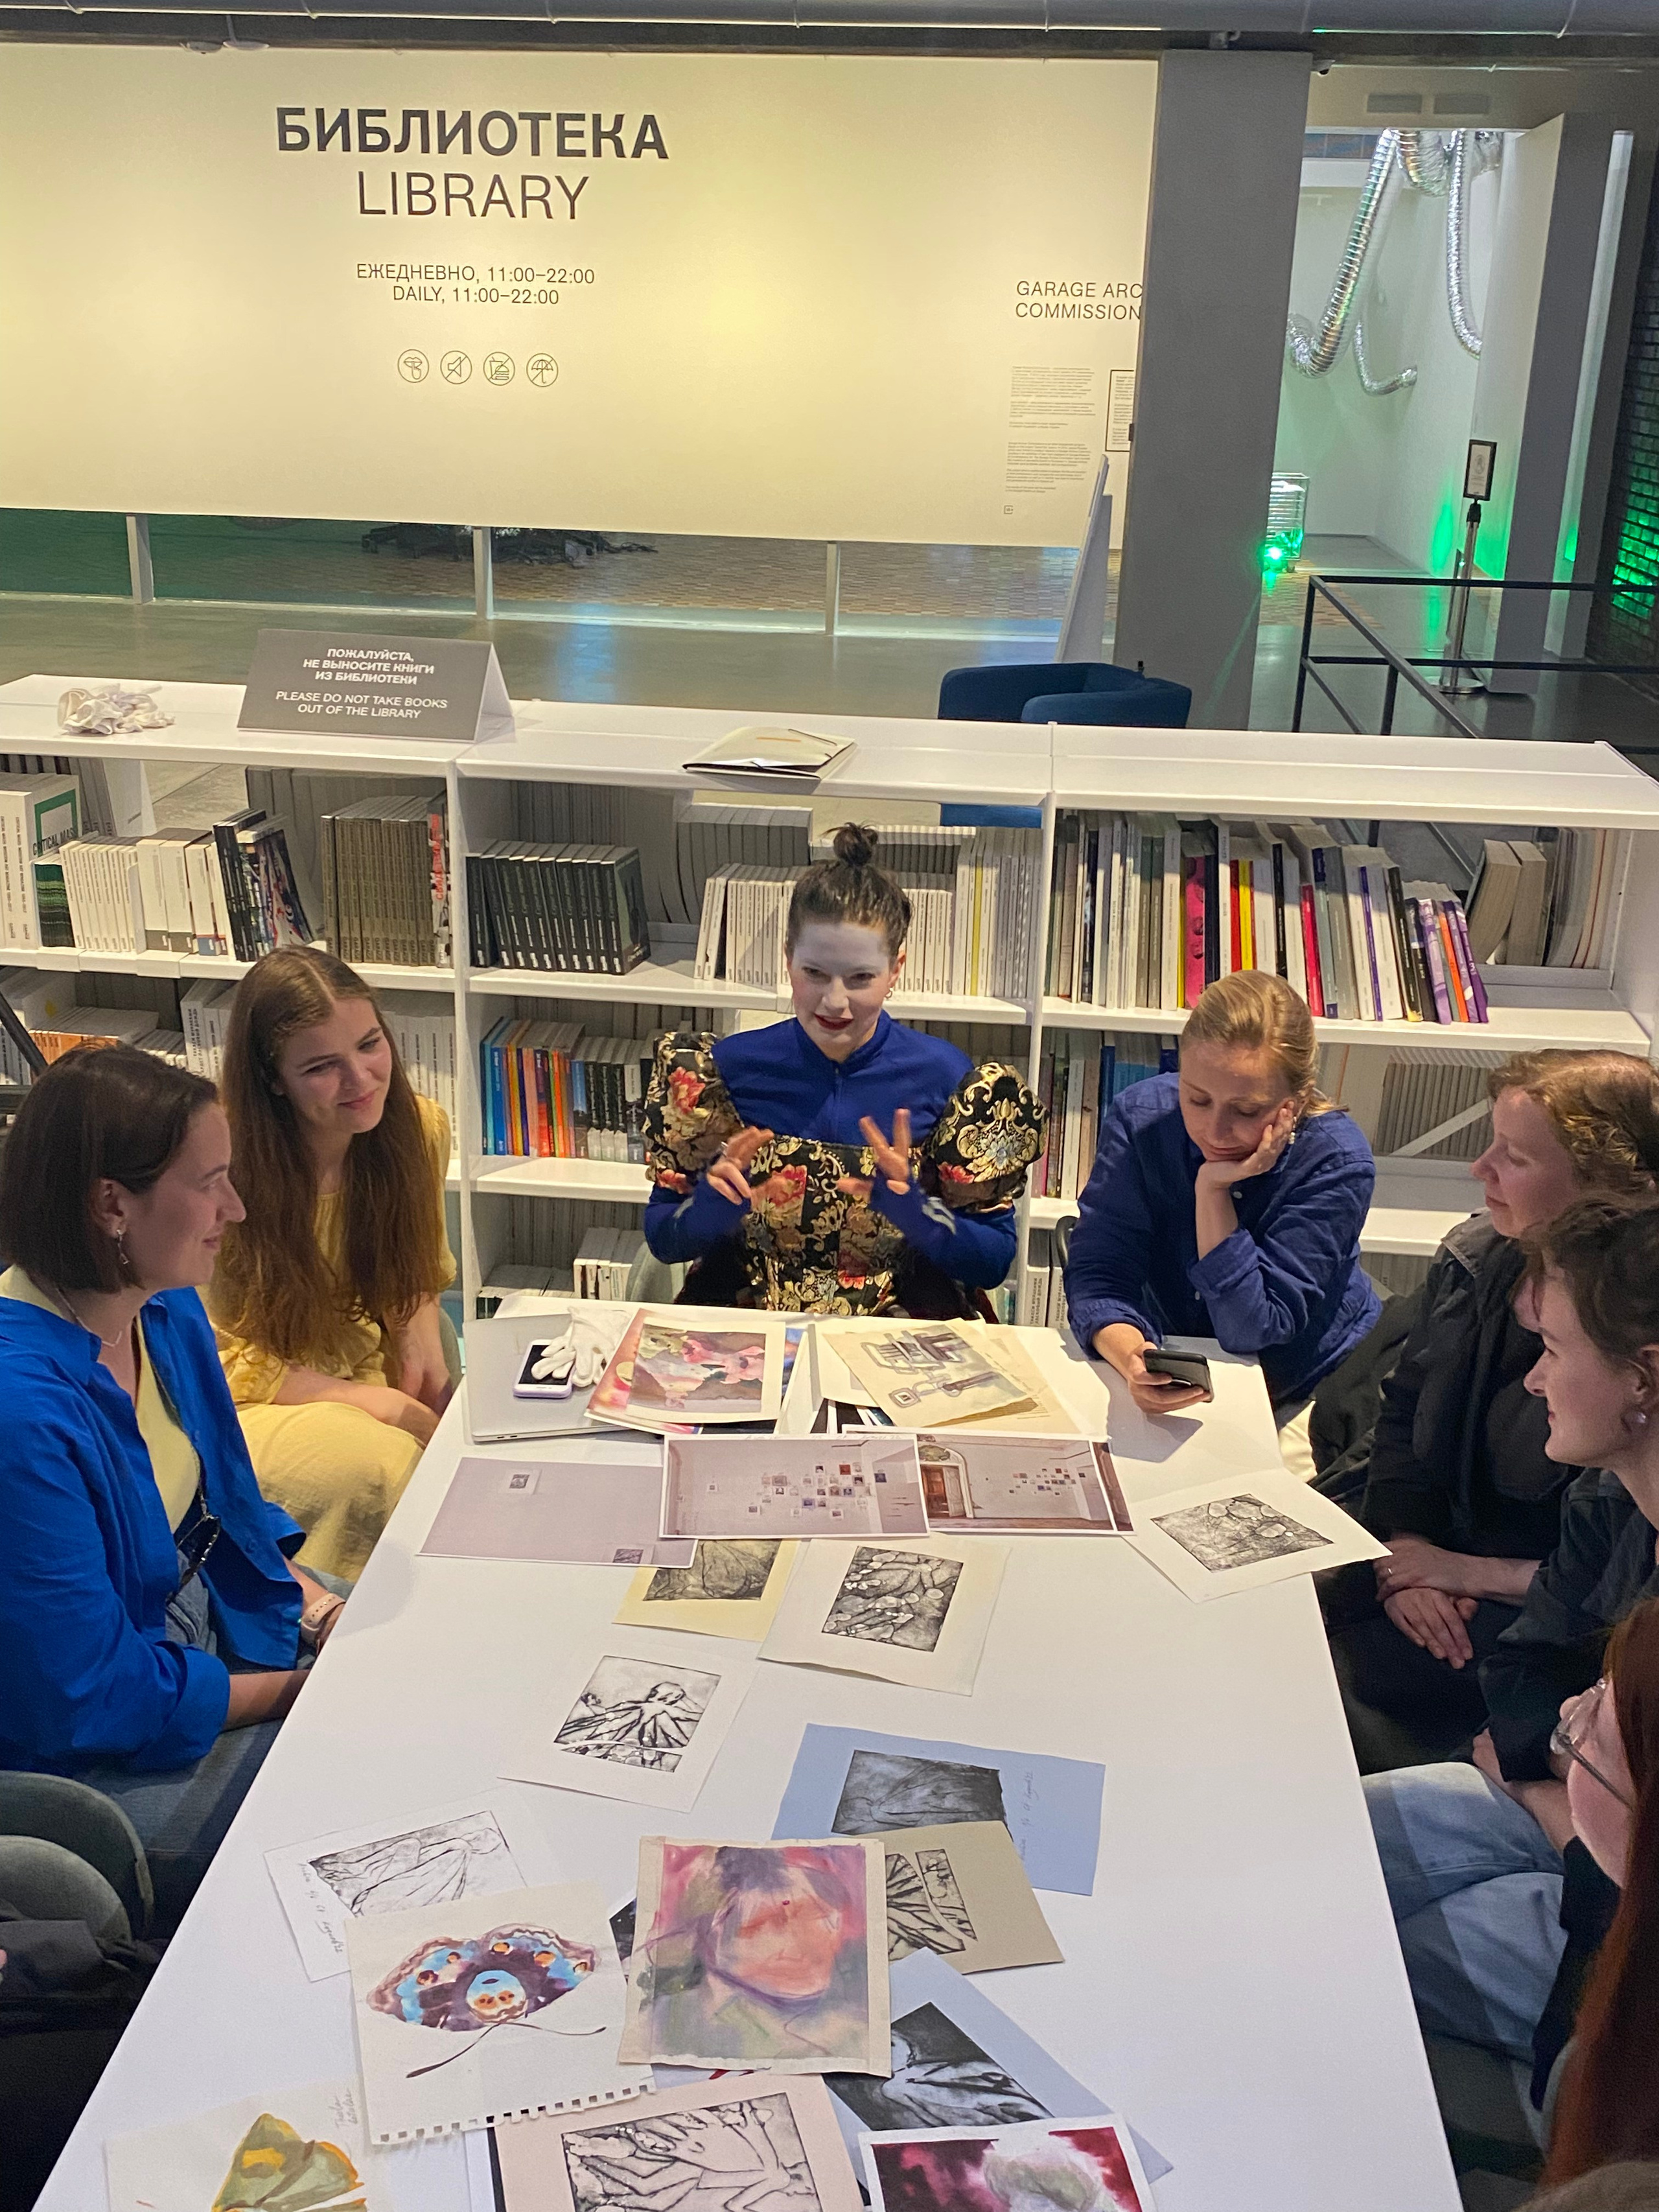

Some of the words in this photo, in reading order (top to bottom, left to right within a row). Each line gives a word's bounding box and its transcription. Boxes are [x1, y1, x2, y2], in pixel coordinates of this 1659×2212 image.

[276, 106, 669, 159] БИБЛИОТЕКА
[357, 170, 590, 220] LIBRARY
[356, 262, 481, 285] ЕЖЕДНЕВНО,
[392, 285, 446, 305] DAILY,
[1016, 280, 1096, 298] GARAGE
[327, 648, 415, 662] ПОЖАЛУЙСТА,
[303, 658, 321, 669] НЕ
[322, 659, 391, 672] ВЫНОСИТЕ
[393, 664, 435, 675] КНИГИ
[315, 671, 333, 681] ИЗ
[334, 671, 417, 685] БИБЛИОТЕКИ
[275, 690, 321, 702] PLEASE
[323, 692, 342, 703] DO
[344, 693, 370, 704] NOT
[373, 695, 402, 706] TAKE
[404, 697, 448, 709] BOOKS
[297, 703, 321, 714] OUT
[325, 704, 343, 715] OF
[345, 705, 369, 716] THE
[371, 706, 422, 719] LIBRARY
